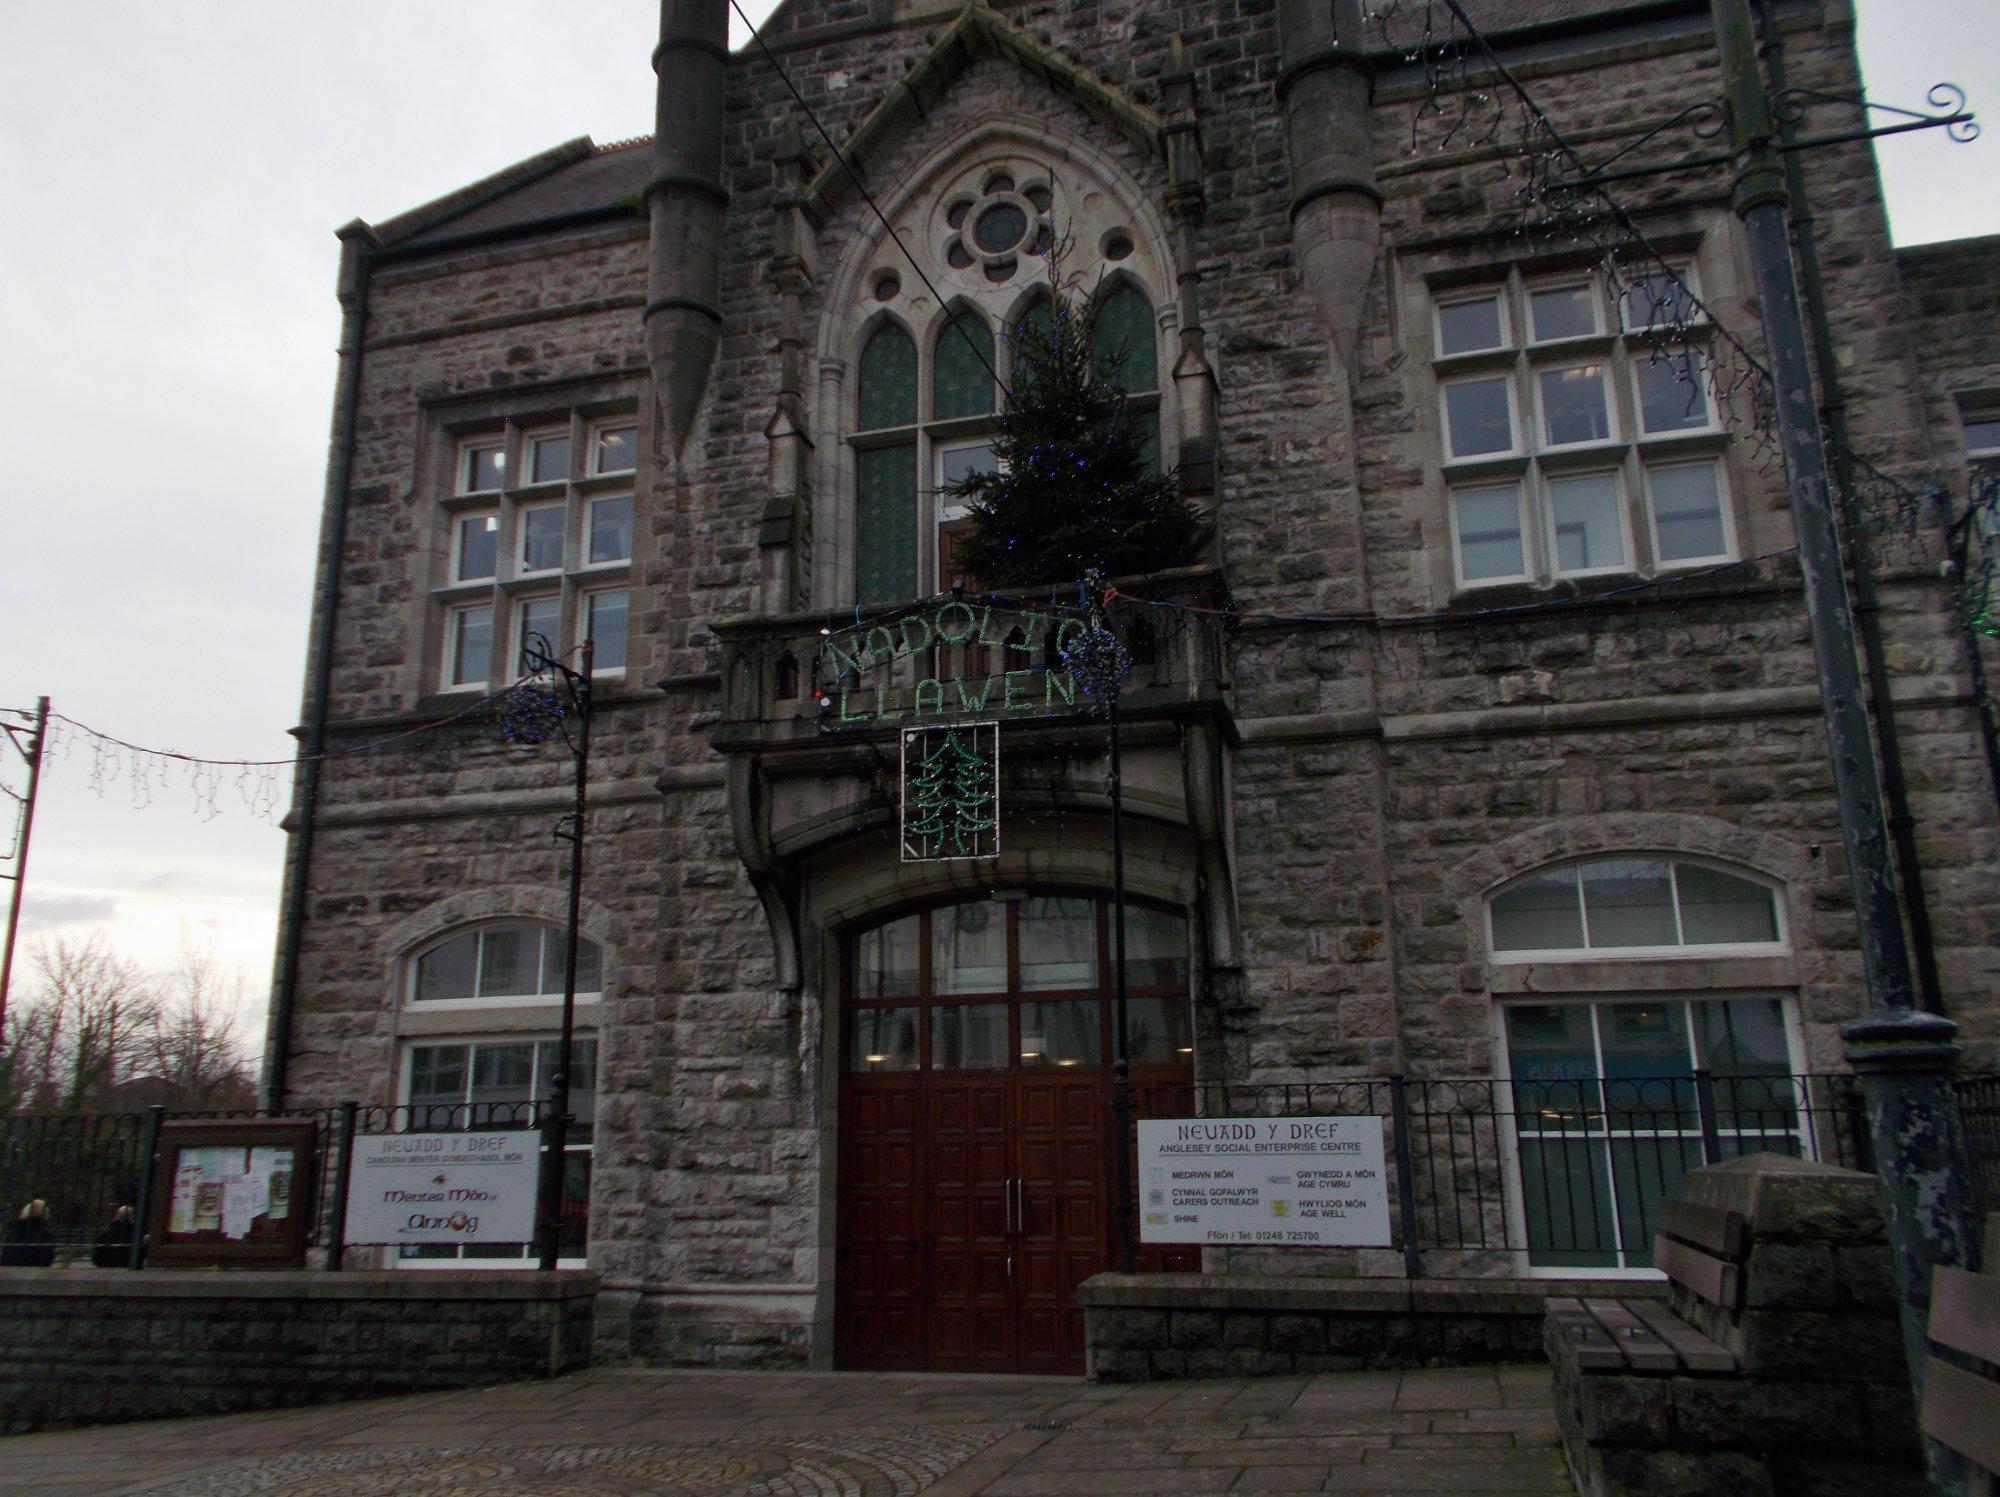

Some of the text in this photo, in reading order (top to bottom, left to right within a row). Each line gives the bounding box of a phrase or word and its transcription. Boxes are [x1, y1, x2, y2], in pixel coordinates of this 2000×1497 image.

[841, 669, 1075, 721] LLAWEN
[1178, 1123, 1339, 1140] NEUADD Y DREF
[383, 1137, 507, 1153] NEUADD Y DREF
[1159, 1142, 1361, 1153] ANGLESEY SOCIAL ENTERPRISE CENTRE
[1172, 1171, 1211, 1179] MEDRWN
[1297, 1170, 1344, 1179] GWYNEDD
[1346, 1171, 1353, 1179] A
[1297, 1180, 1350, 1189] AGE CYMRU
[383, 1189, 445, 1204] Menter
[1172, 1188, 1258, 1197] CYNNAL GOFALWYR
[1173, 1198, 1259, 1206] CARERS OUTREACH
[1300, 1210, 1346, 1218] AGE WELL
[1174, 1215, 1199, 1223] SHINE
[1237, 1231, 1252, 1240] Tel:
[1255, 1231, 1283, 1240] 01248
[1286, 1231, 1320, 1241] 725700
